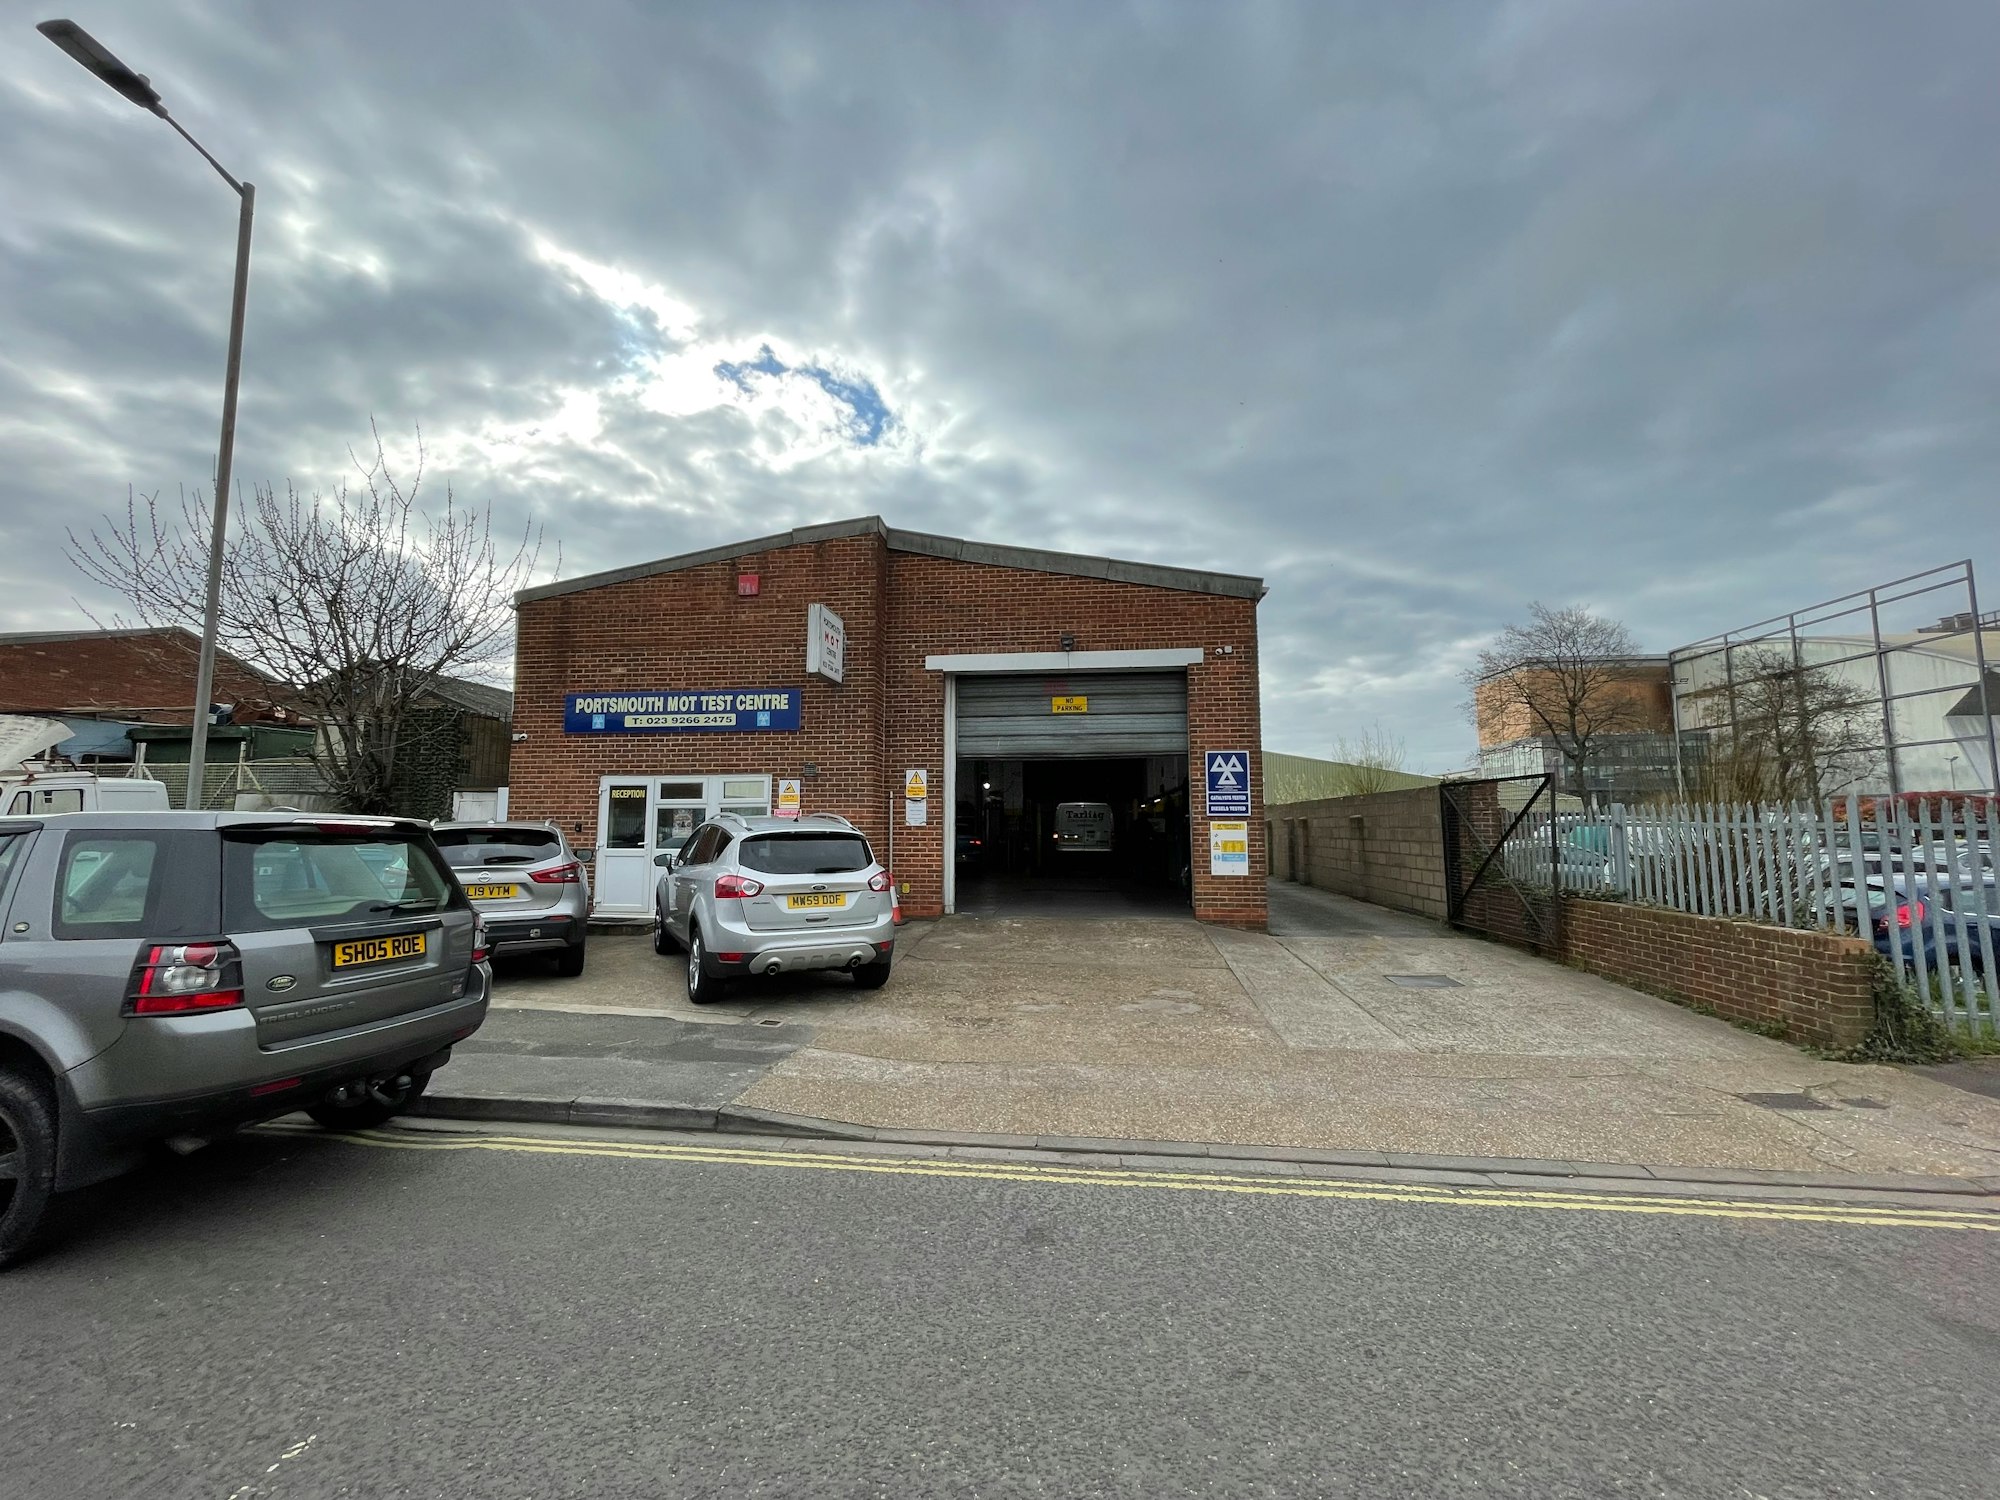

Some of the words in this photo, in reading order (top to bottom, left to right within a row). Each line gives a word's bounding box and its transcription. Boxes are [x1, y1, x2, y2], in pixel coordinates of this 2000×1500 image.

[575, 697, 664, 713] PORTSMOUTH
[667, 696, 697, 712] MOT
[700, 695, 733, 711] TEST
[736, 694, 789, 711] CENTRE
[632, 717, 643, 725] T:
[646, 716, 668, 725] 023
[671, 716, 700, 724] 9266
[703, 715, 733, 724] 2475
[611, 789, 646, 799] RECEPTION
[464, 886, 485, 897] L19
[488, 886, 510, 896] VTM
[792, 895, 820, 906] MW59
[341, 940, 388, 963] SH05
[392, 936, 421, 956] ROE
[259, 1003, 344, 1025] FREELANDER
